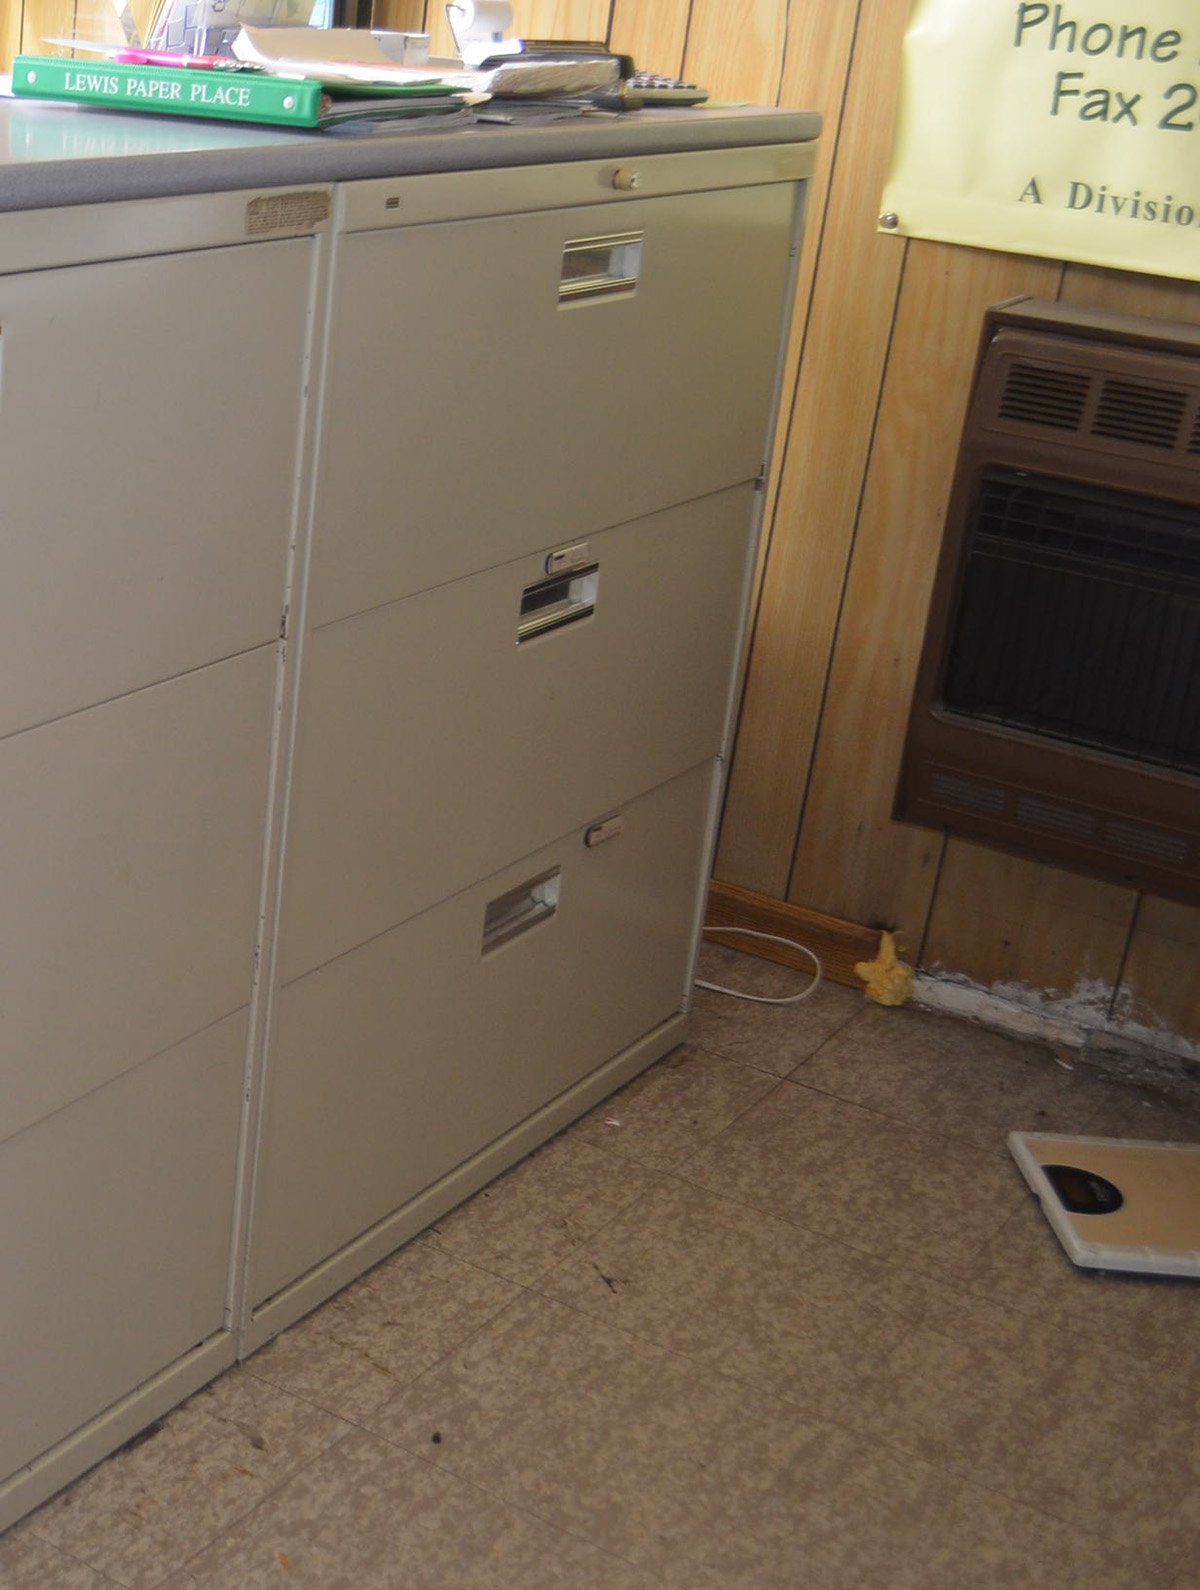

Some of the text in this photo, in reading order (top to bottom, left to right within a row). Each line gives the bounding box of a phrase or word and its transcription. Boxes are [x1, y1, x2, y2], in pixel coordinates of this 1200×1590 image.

[1013, 2, 1182, 63] Phone
[64, 73, 251, 107] LEWIS PAPER PLACE
[1050, 71, 1200, 132] Fax 2
[1017, 177, 1200, 227] A Divisio
